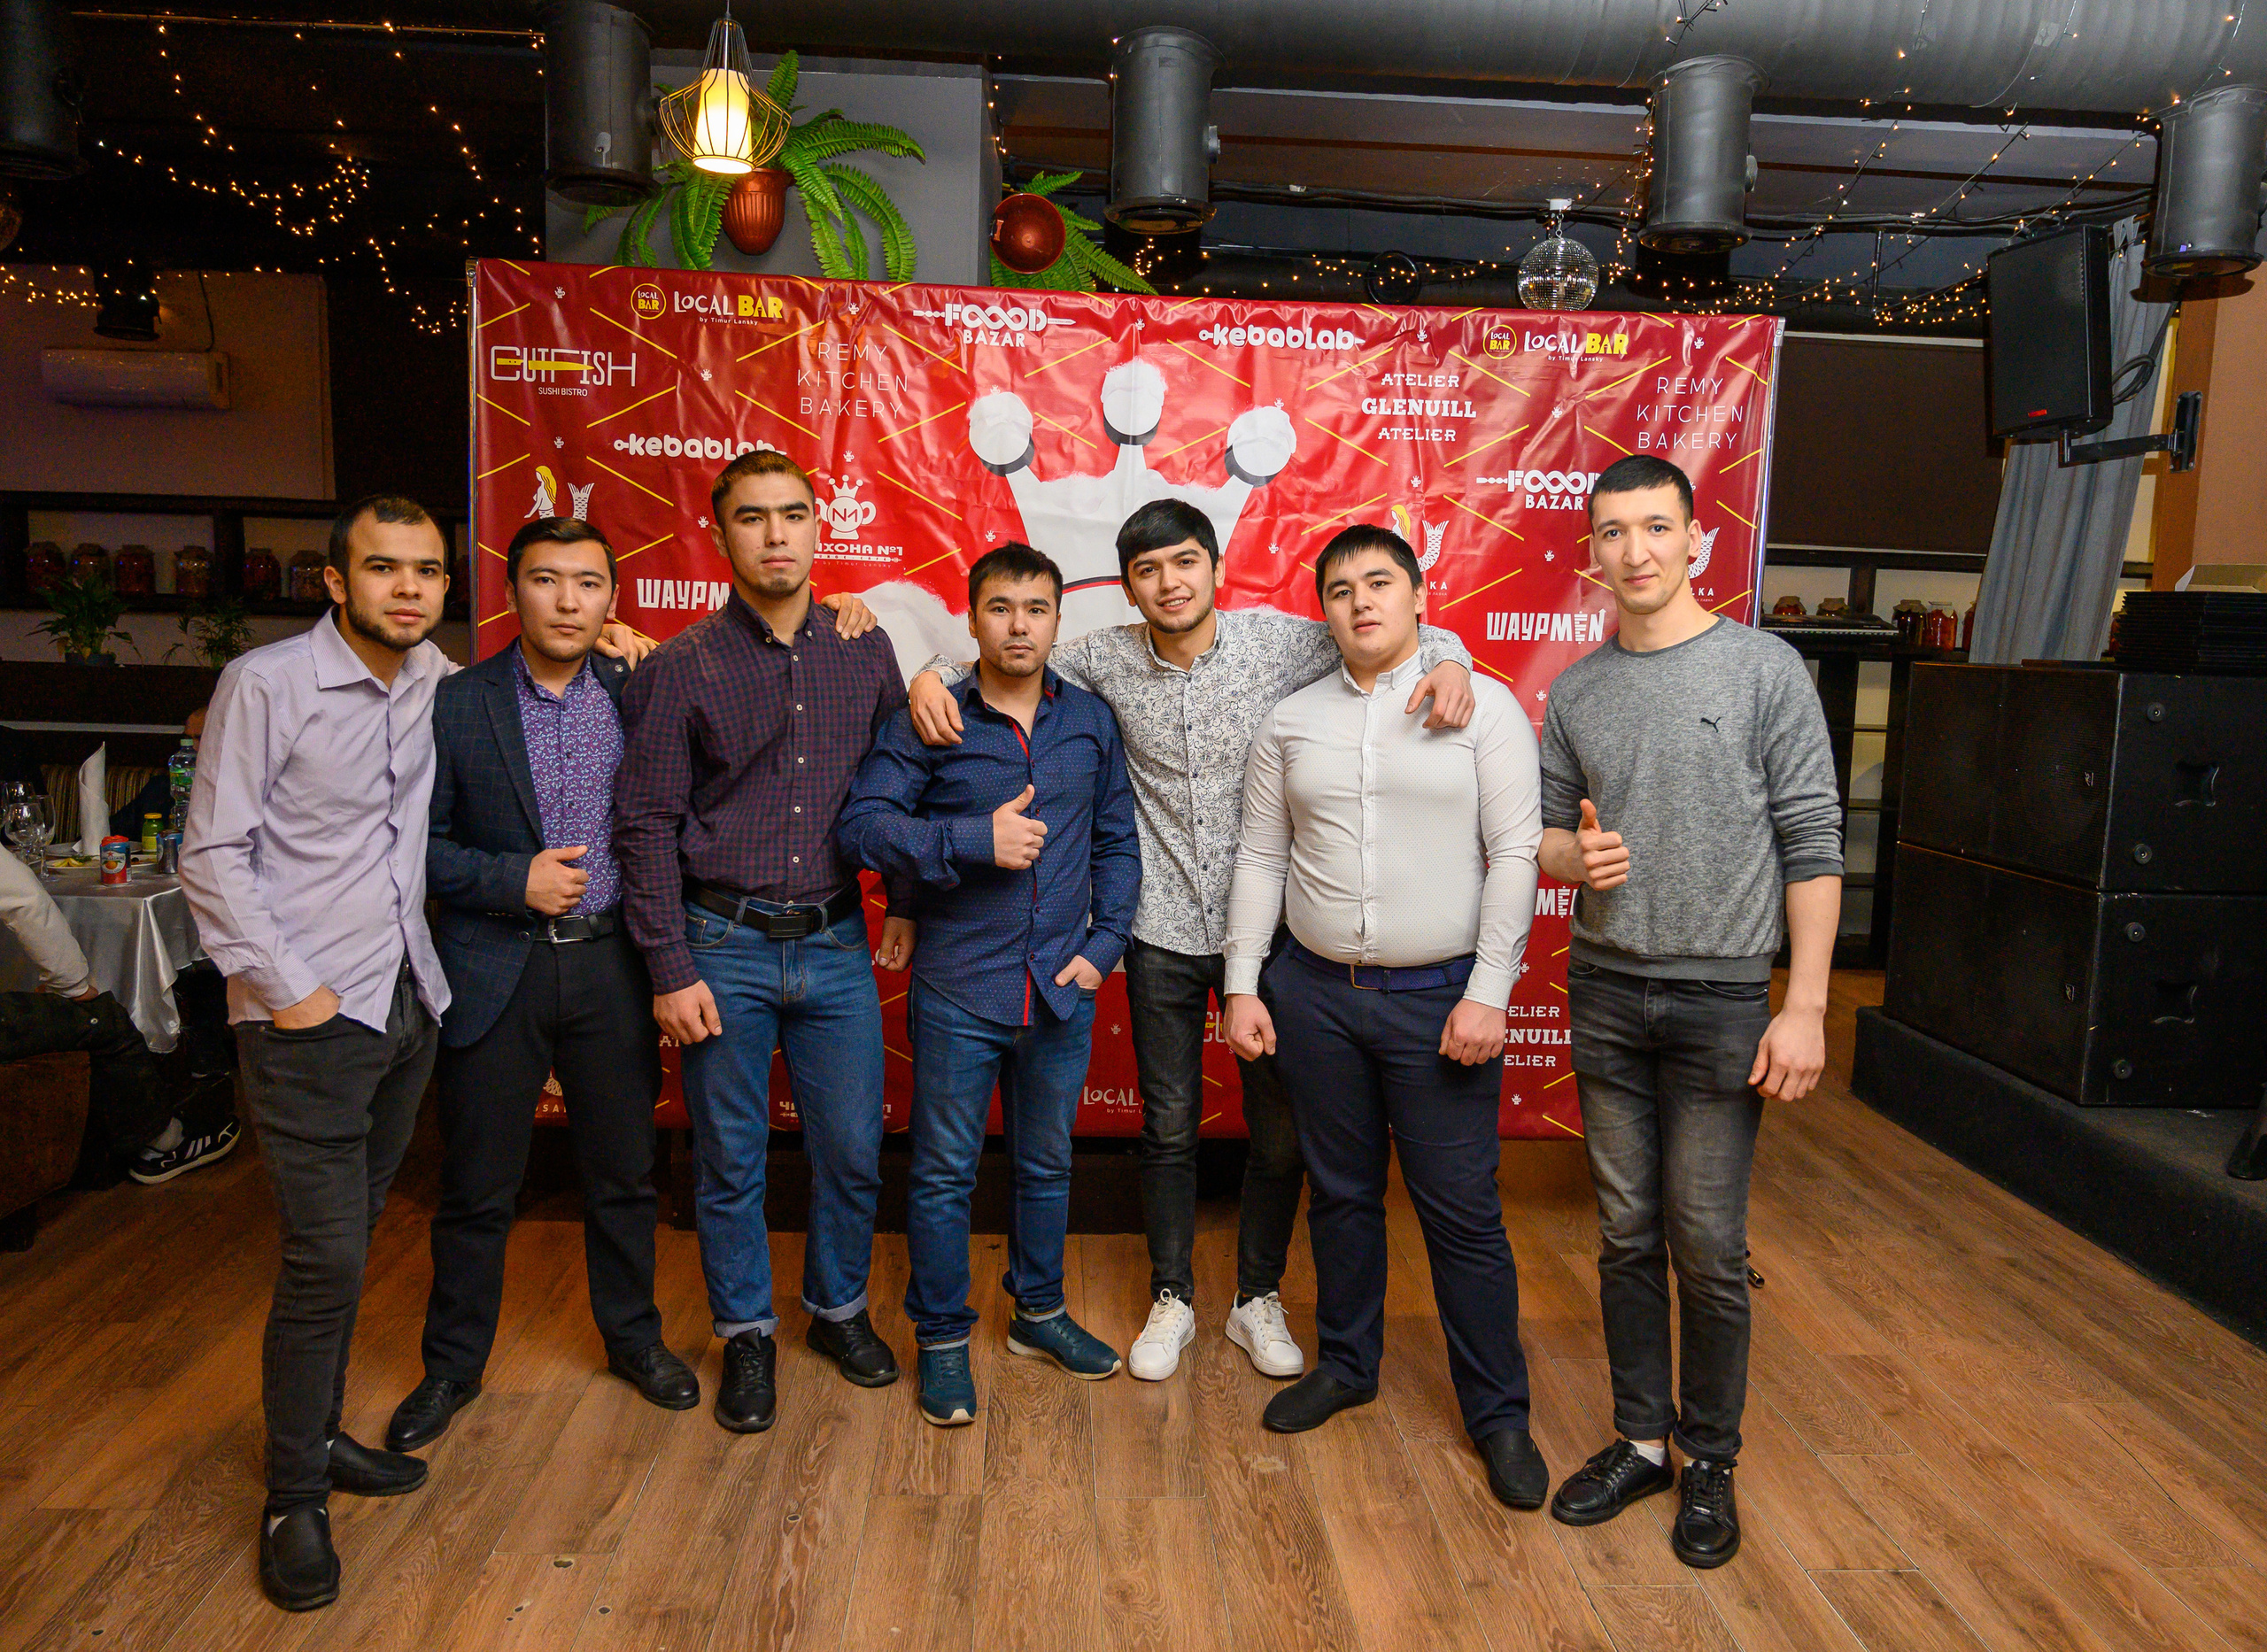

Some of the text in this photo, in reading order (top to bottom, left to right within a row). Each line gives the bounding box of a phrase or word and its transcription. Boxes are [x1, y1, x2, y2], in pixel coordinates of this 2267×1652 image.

[638, 299, 660, 310] BAR
[738, 295, 783, 319] BAR
[963, 329, 1025, 348] BAZAR
[1489, 339, 1511, 351] BAR
[1585, 332, 1629, 355] BAR
[818, 342, 887, 362] REMY
[797, 369, 908, 392] KITCHEN
[1381, 373, 1459, 388] ATELIER
[1657, 376, 1724, 395] REMY
[800, 397, 902, 420] BAKERY
[1361, 397, 1477, 418] GLENUILL
[1636, 404, 1744, 423] KITCHEN
[1377, 427, 1457, 442] ATELIER
[1637, 431, 1737, 450] BAKERY
[1525, 494, 1584, 510] BAZAR
[637, 578, 731, 611] ШАУРМ
[1507, 1006, 1560, 1017] ELIER
[1504, 1054, 1557, 1067] ELIER
